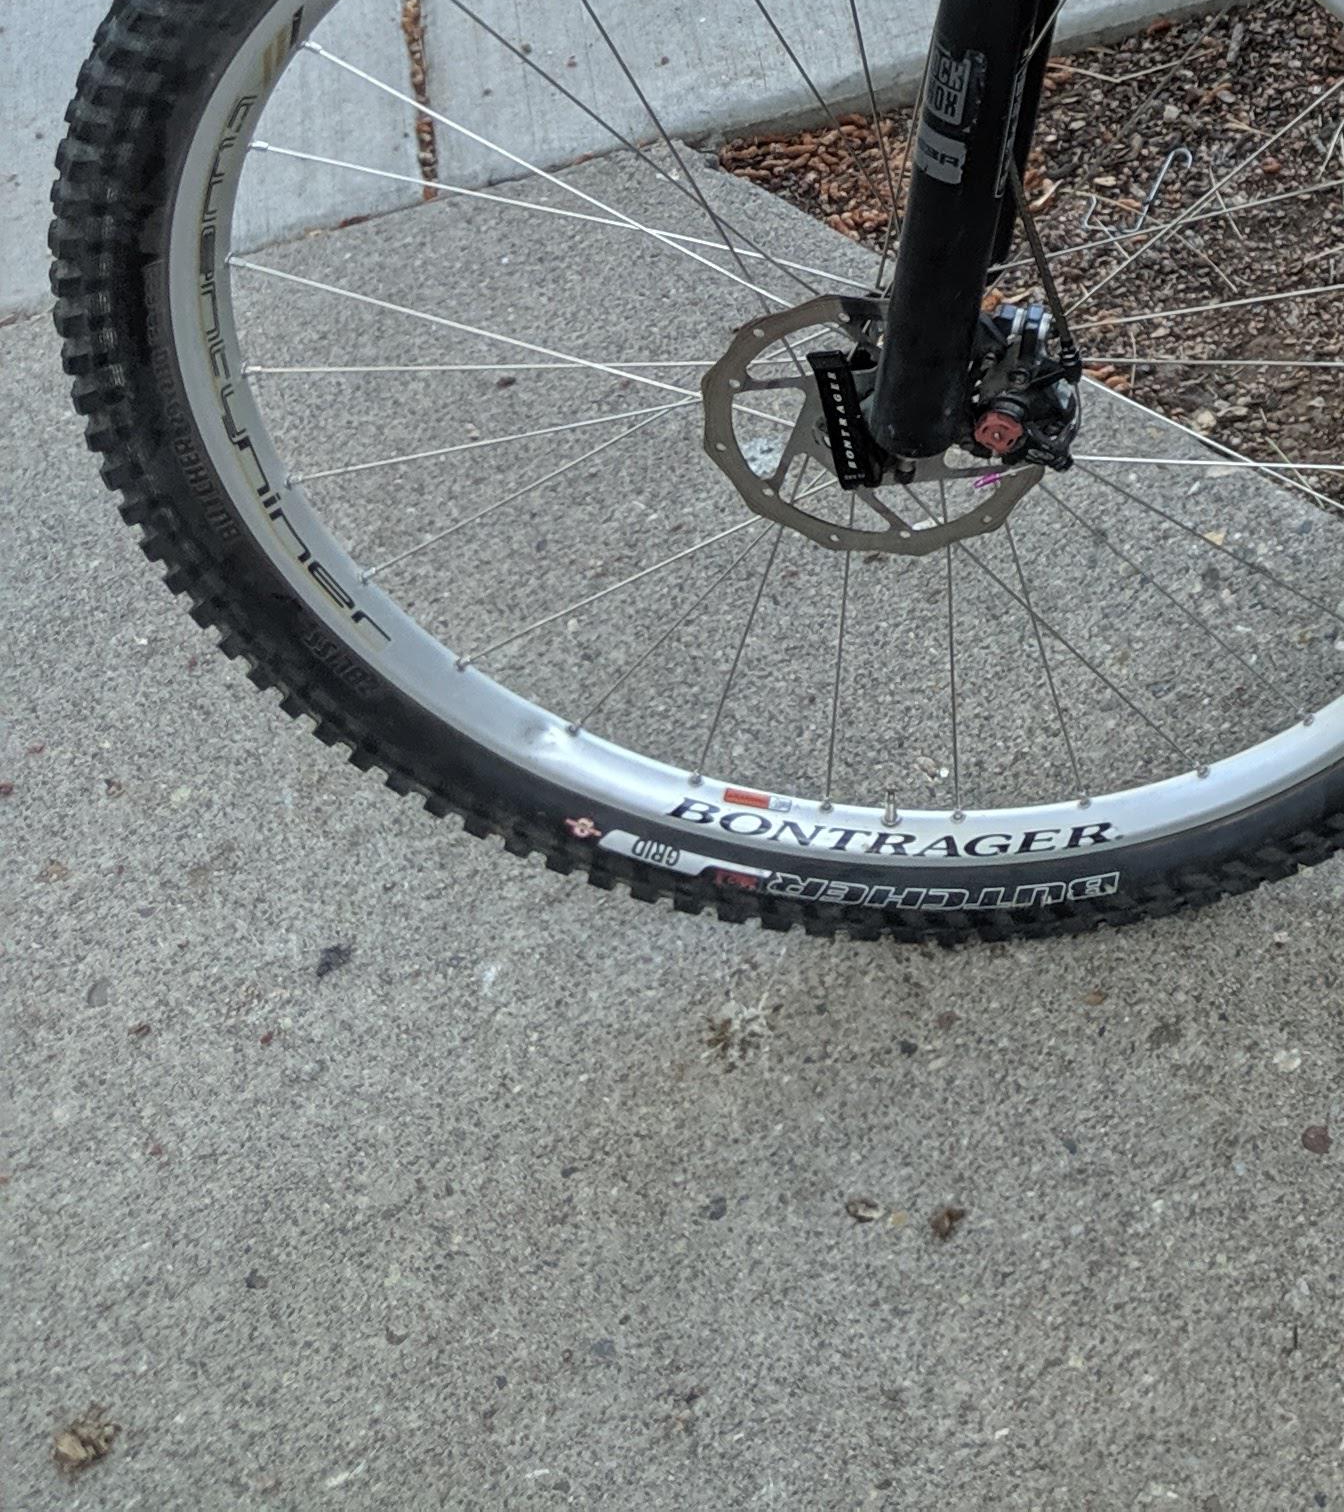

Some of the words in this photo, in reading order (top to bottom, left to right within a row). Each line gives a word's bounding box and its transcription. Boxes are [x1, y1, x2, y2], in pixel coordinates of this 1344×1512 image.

[667, 796, 1114, 859] BONTRAGER
[631, 837, 683, 868] GRID
[764, 869, 1121, 911] BUTCHER
